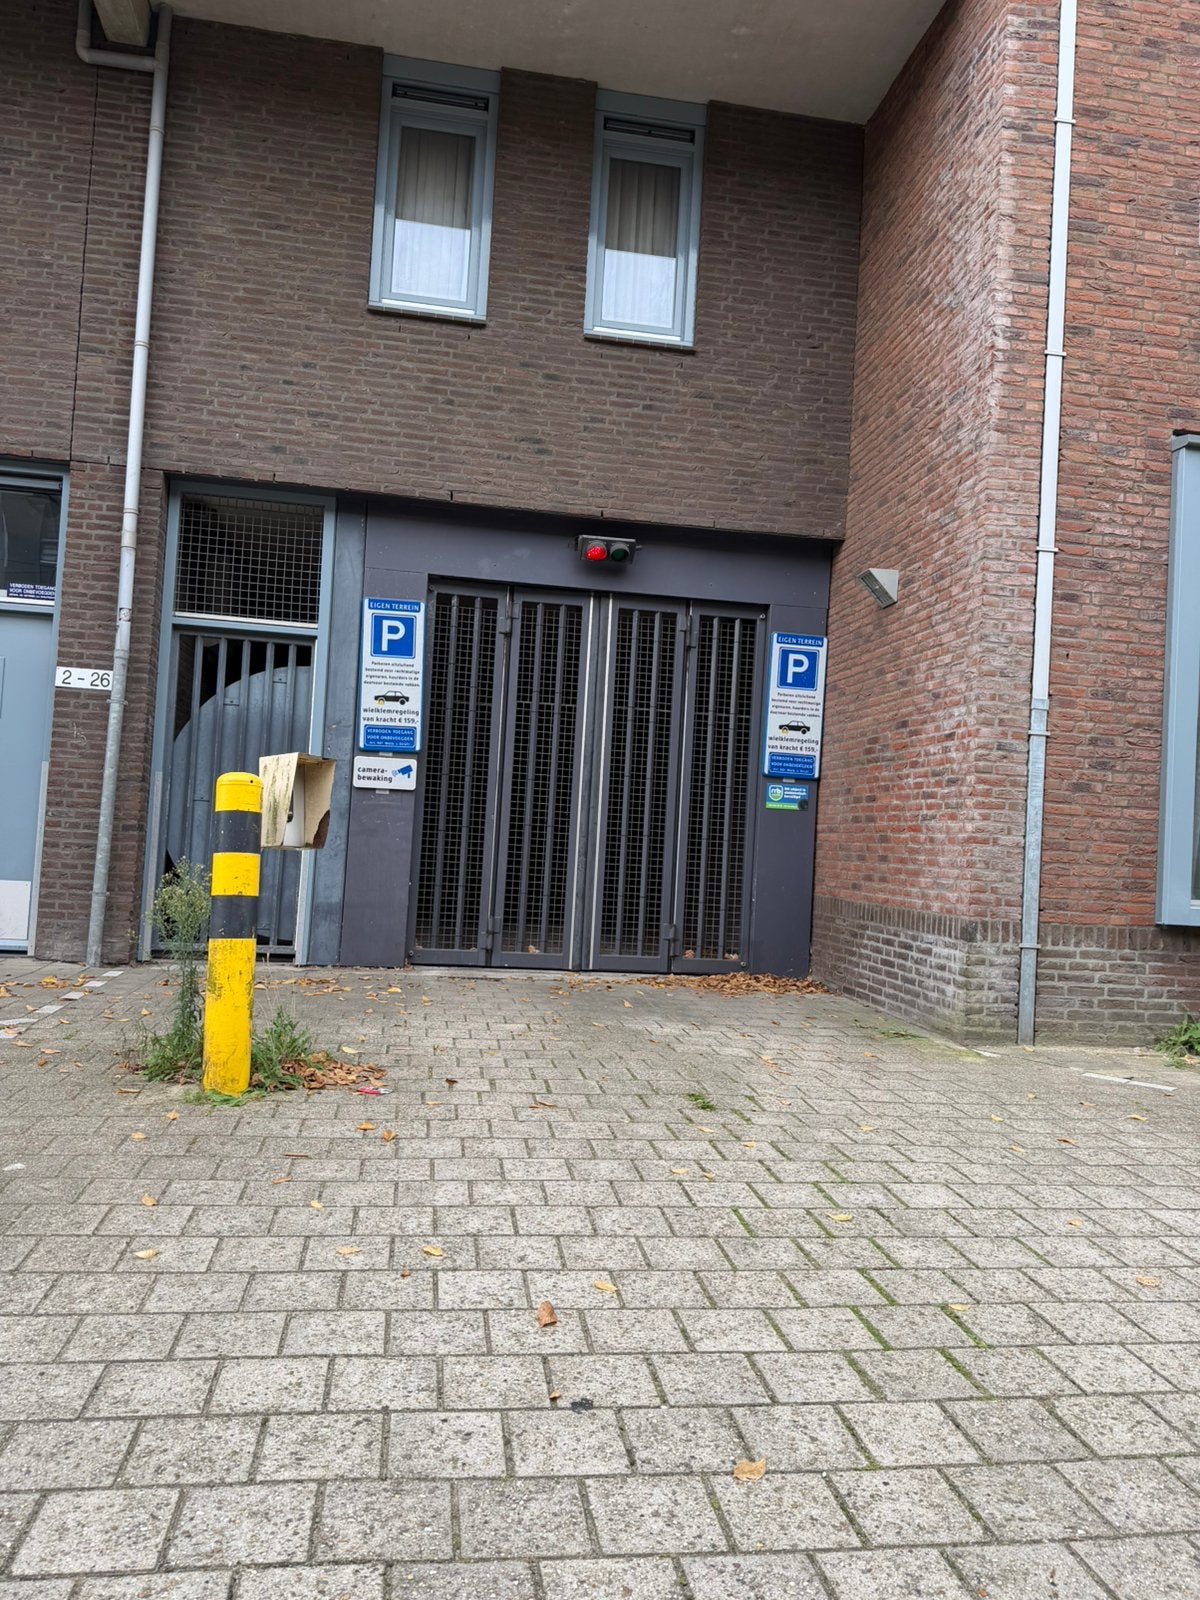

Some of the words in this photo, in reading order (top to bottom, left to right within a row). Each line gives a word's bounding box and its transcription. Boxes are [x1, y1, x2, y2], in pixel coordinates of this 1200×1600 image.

[392, 603, 419, 611] TERREIN
[382, 619, 406, 651] P
[798, 638, 823, 646] TERREIN
[787, 653, 809, 683] P
[61, 669, 72, 685] 2
[90, 671, 111, 688] 26
[362, 707, 420, 717] wielklemregeling
[768, 736, 819, 746] wielklemregeling
[357, 766, 388, 774] camera-
[357, 774, 393, 783] bewaking
